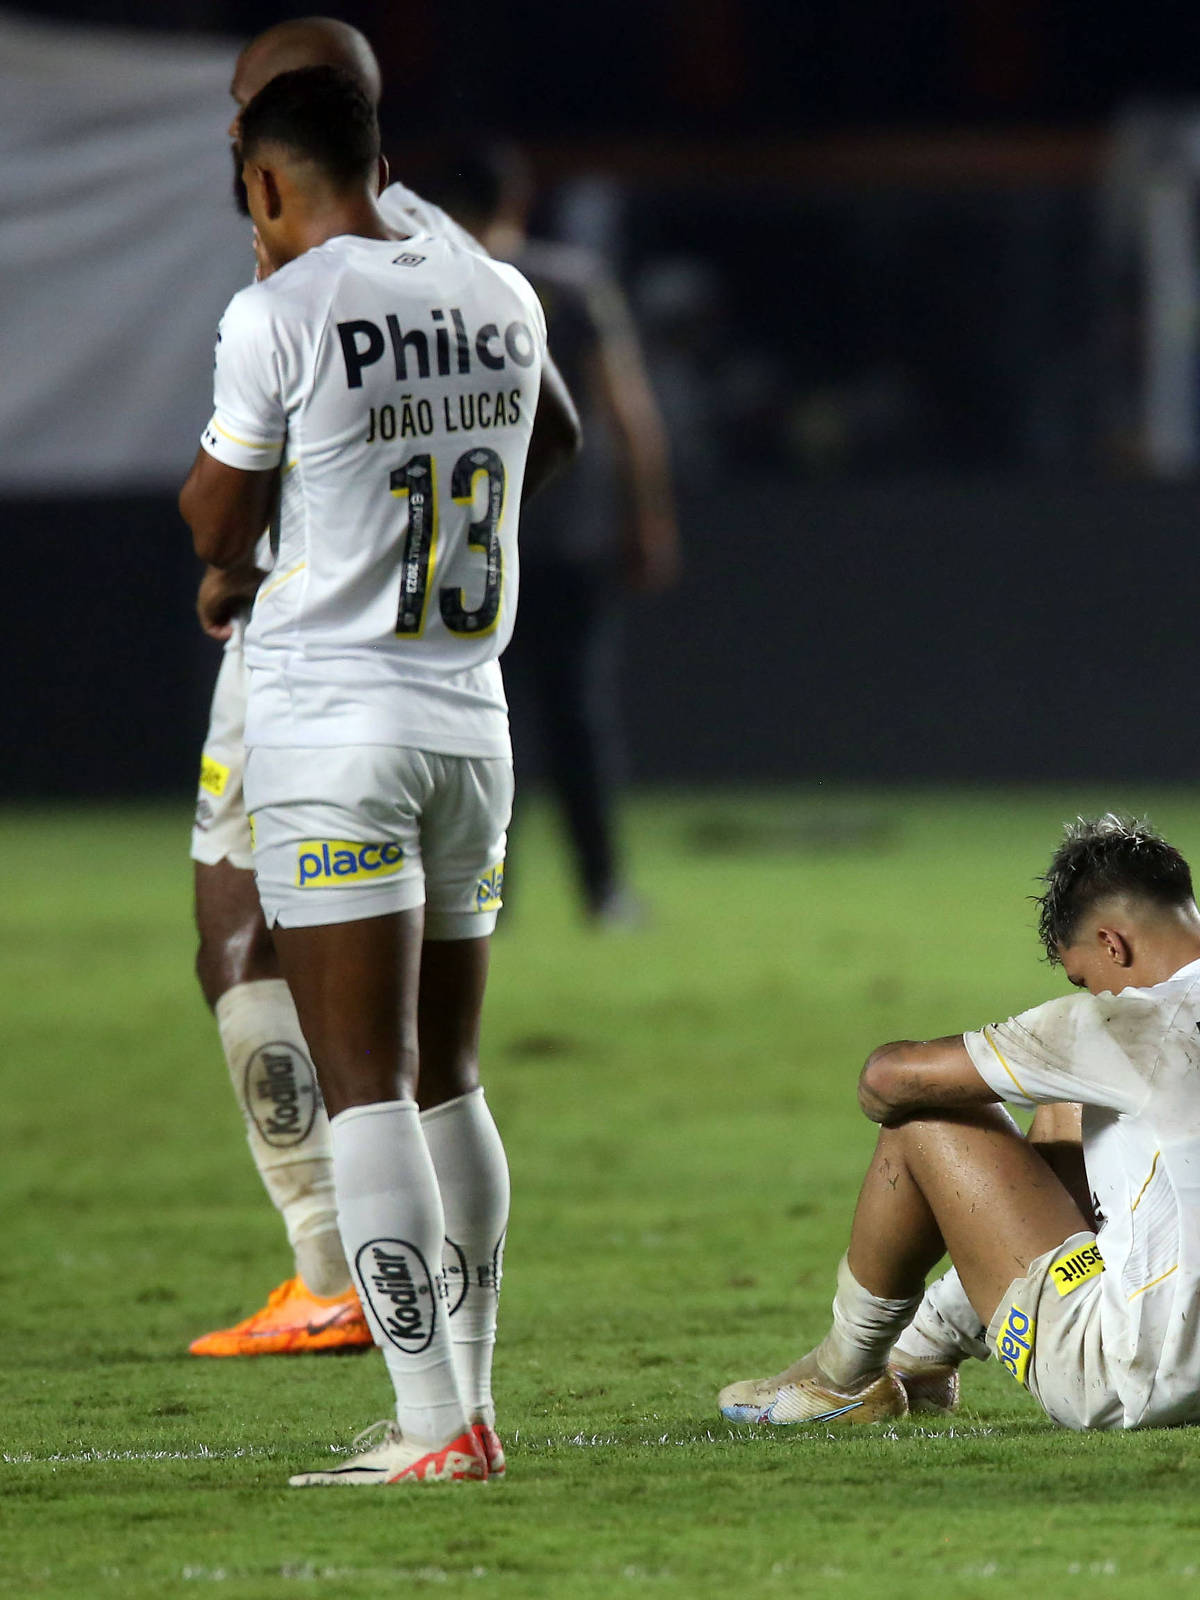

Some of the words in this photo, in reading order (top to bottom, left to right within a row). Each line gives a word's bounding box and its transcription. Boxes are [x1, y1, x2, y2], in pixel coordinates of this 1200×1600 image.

[337, 308, 534, 389] Philco
[366, 395, 434, 444] JOÃO
[444, 389, 521, 432] LUCAS
[390, 447, 508, 640] 13
[299, 842, 404, 886] placo
[371, 1247, 427, 1340] Kodilar
[1054, 1245, 1106, 1282] asilit
